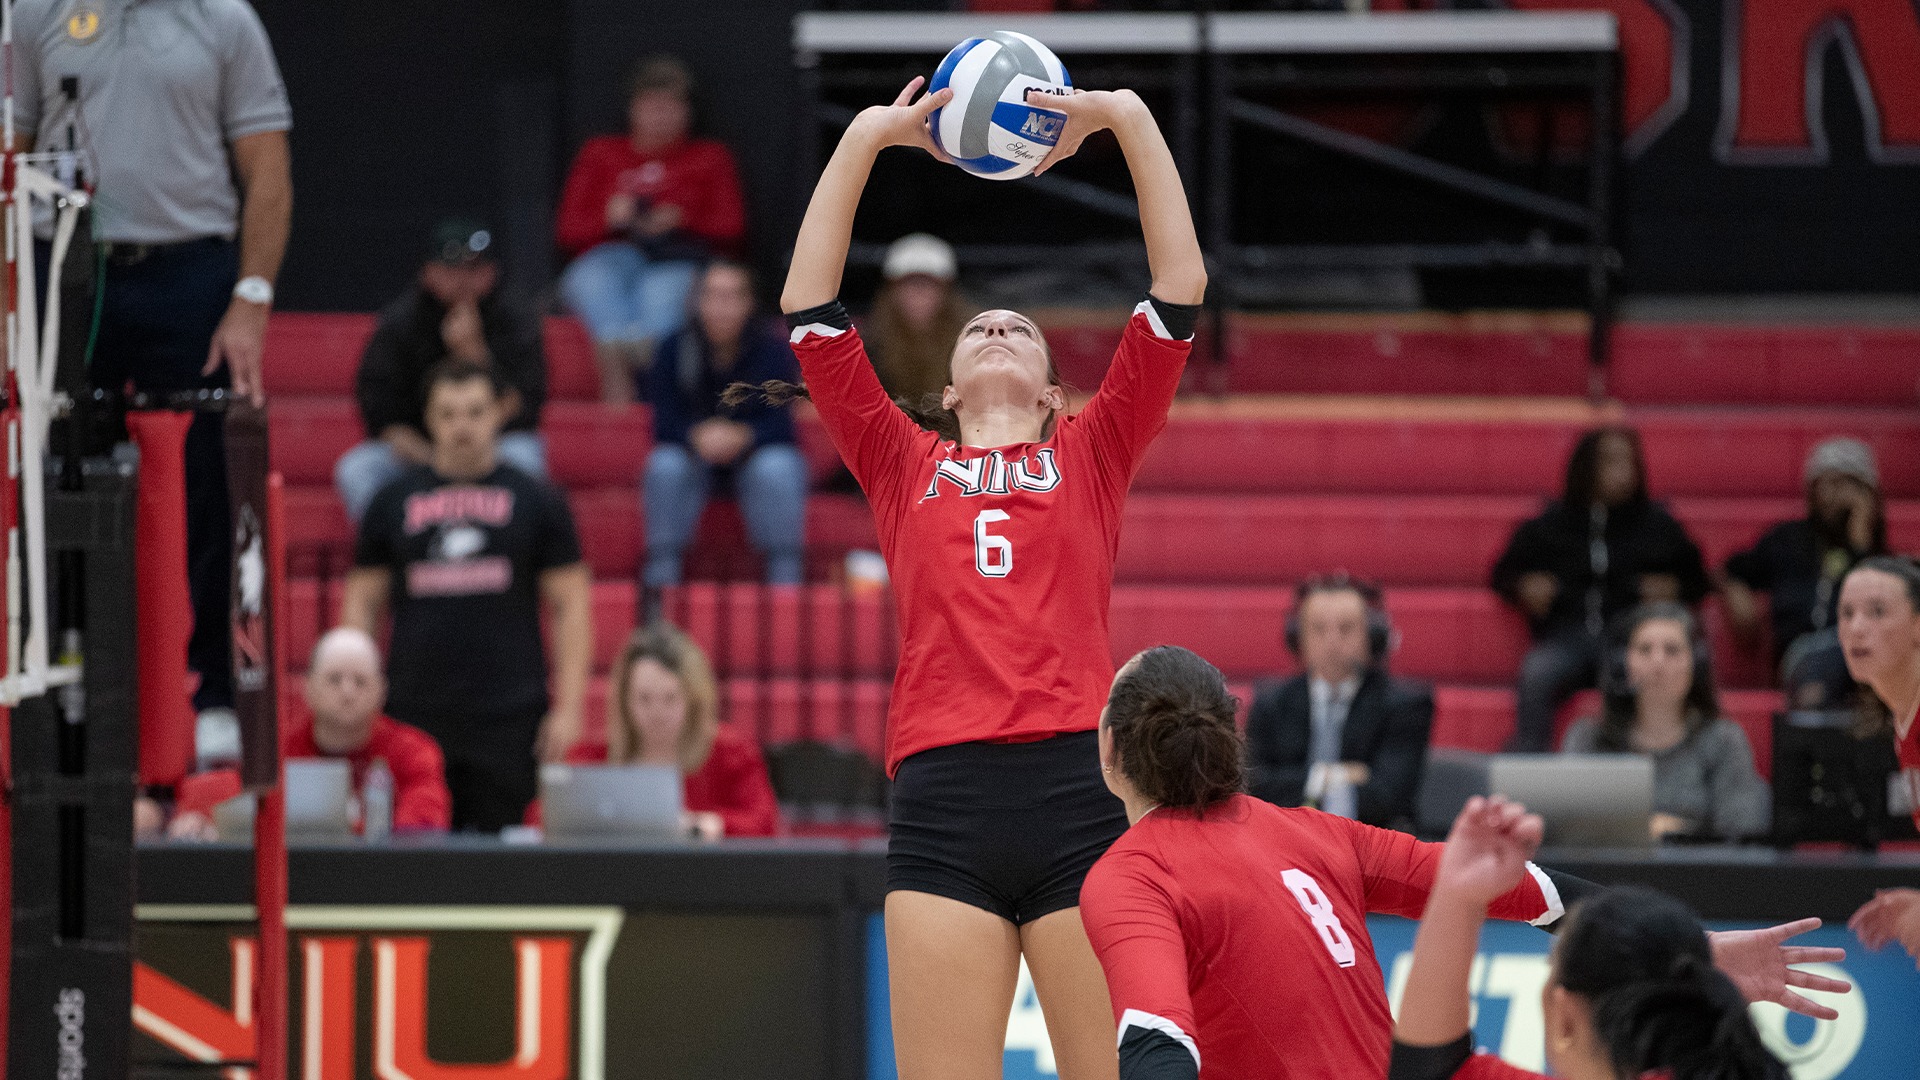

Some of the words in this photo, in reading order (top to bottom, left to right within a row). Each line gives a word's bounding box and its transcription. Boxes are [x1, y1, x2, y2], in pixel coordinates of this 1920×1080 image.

[1006, 141, 1034, 159] Super
[920, 448, 1062, 502] NIU
[974, 508, 1013, 578] 6
[1280, 868, 1356, 969] 8
